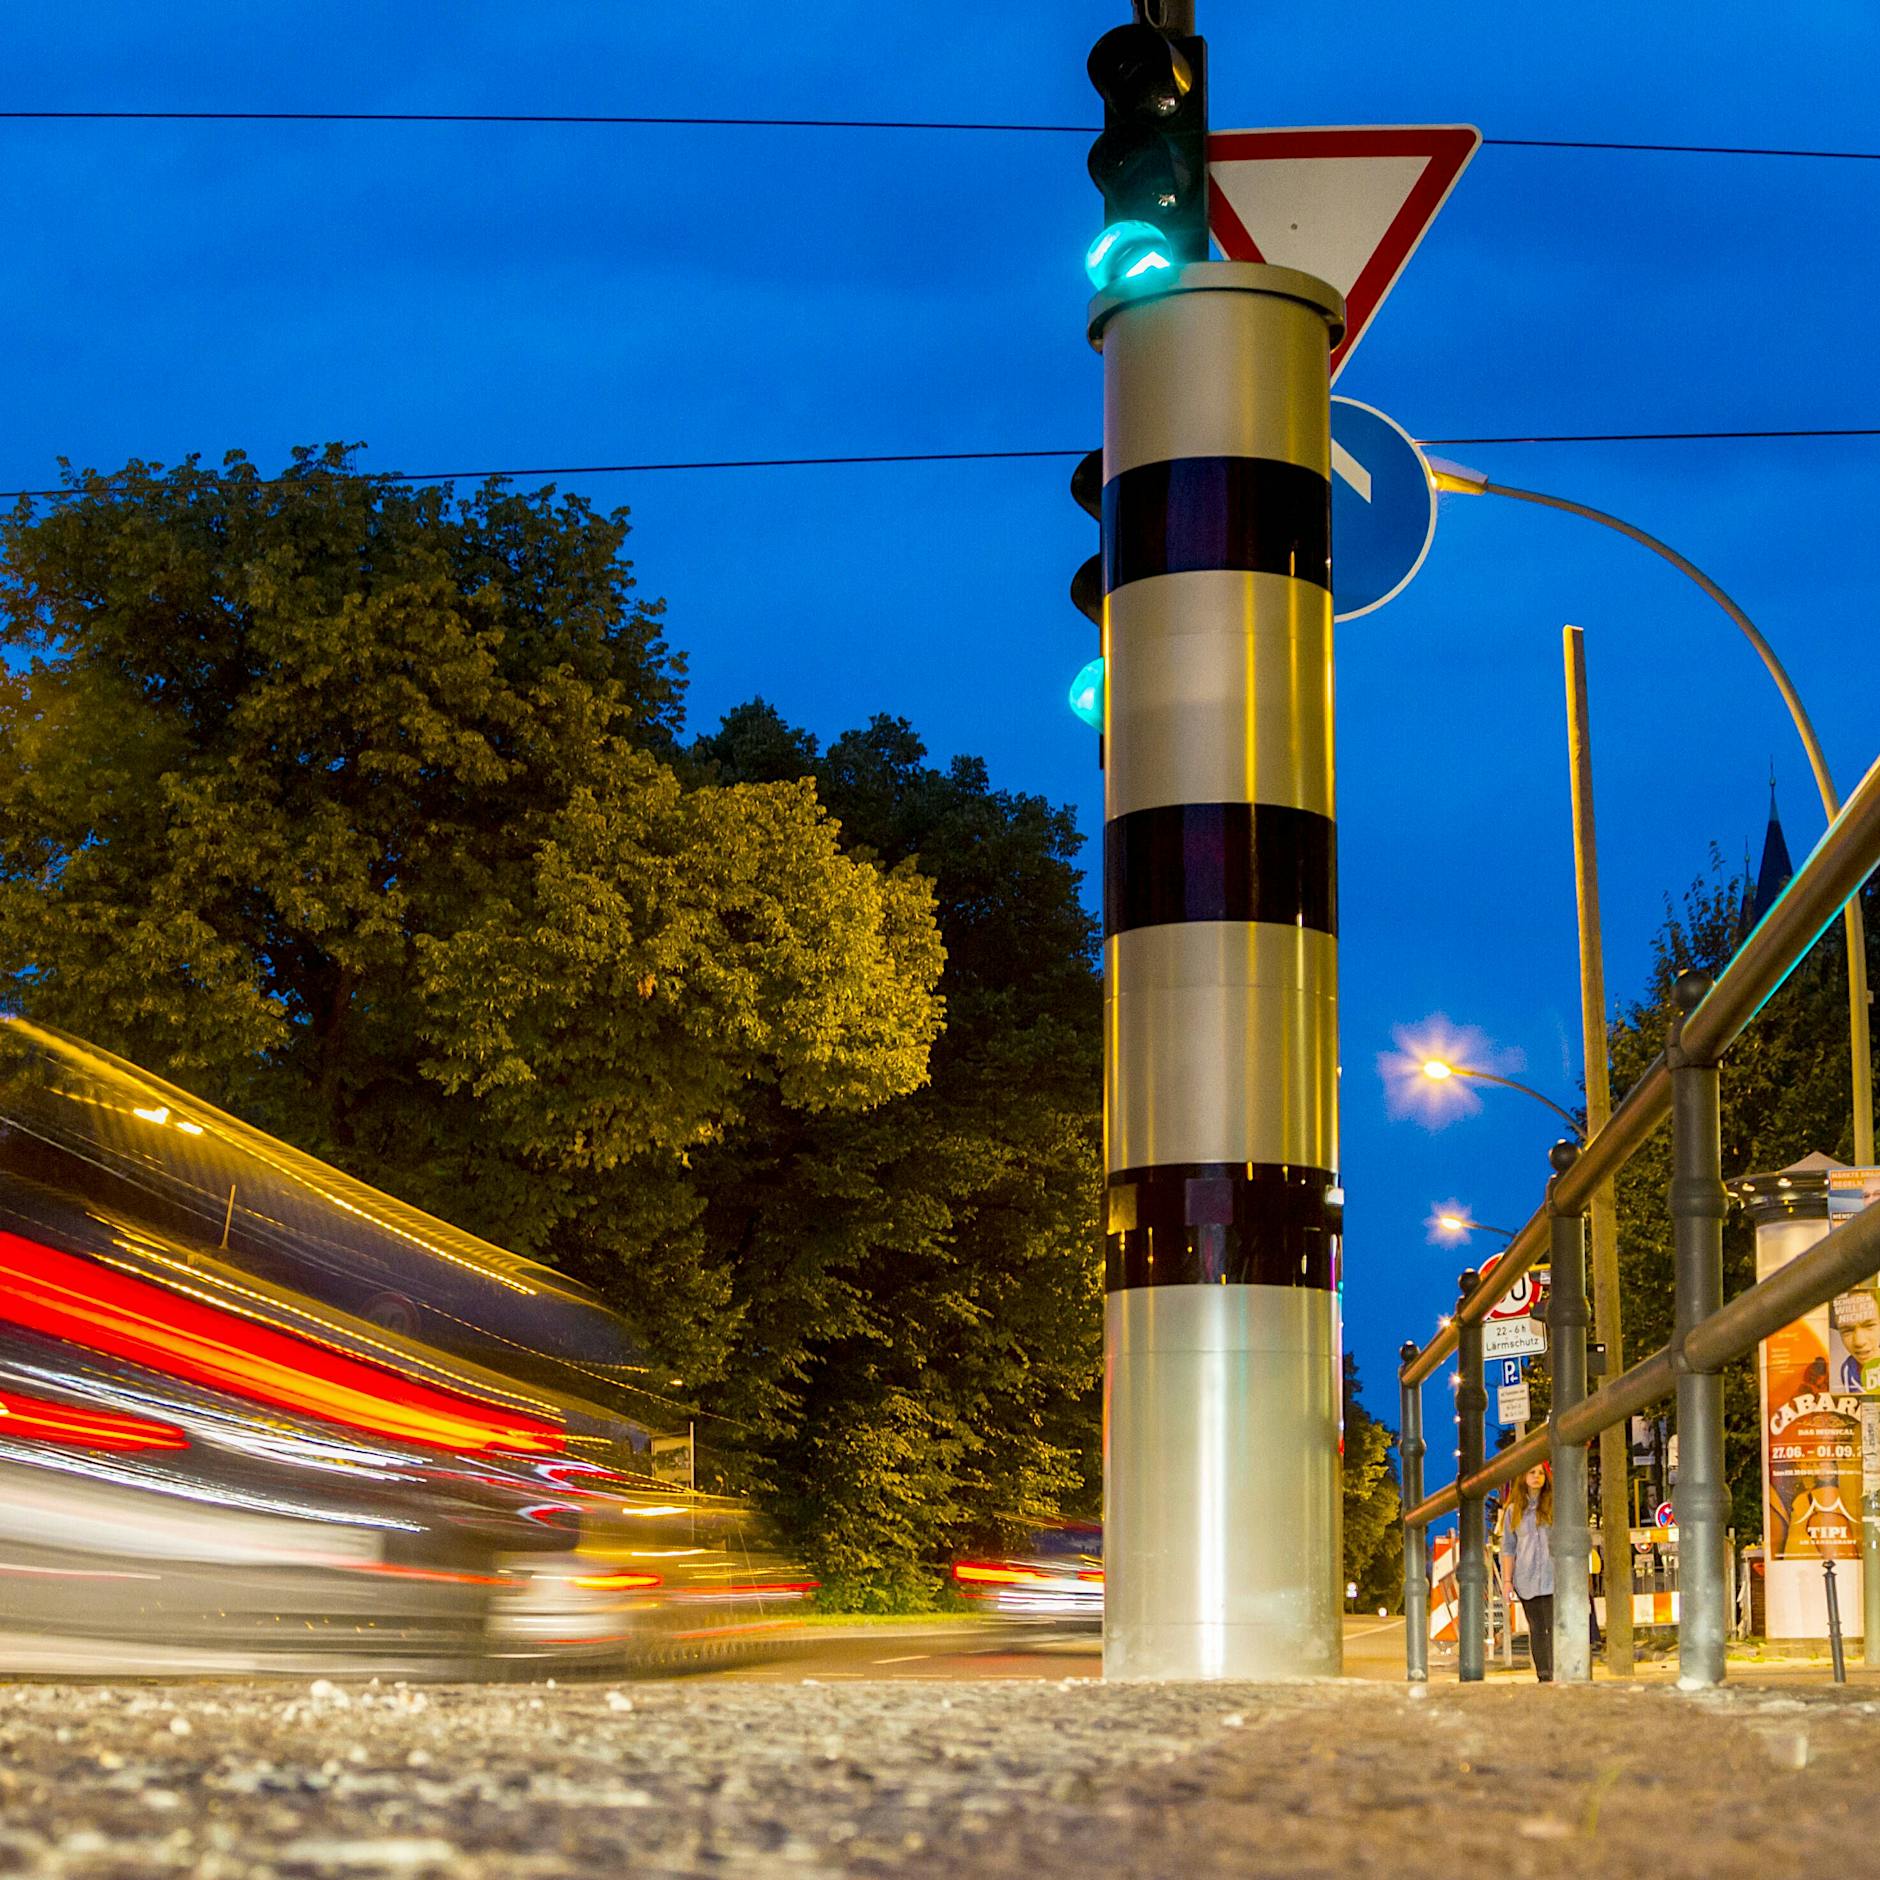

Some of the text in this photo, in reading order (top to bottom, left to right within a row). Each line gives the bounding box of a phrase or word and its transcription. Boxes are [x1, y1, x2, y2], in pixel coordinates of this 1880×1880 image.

[1496, 1326, 1508, 1337] 22
[1515, 1325, 1521, 1335] 6
[1486, 1337, 1540, 1351] Lärmschutz
[1769, 1392, 1861, 1436] CABAR
[1772, 1446, 1805, 1459] 27.06.
[1807, 1526, 1848, 1539] TIPI
